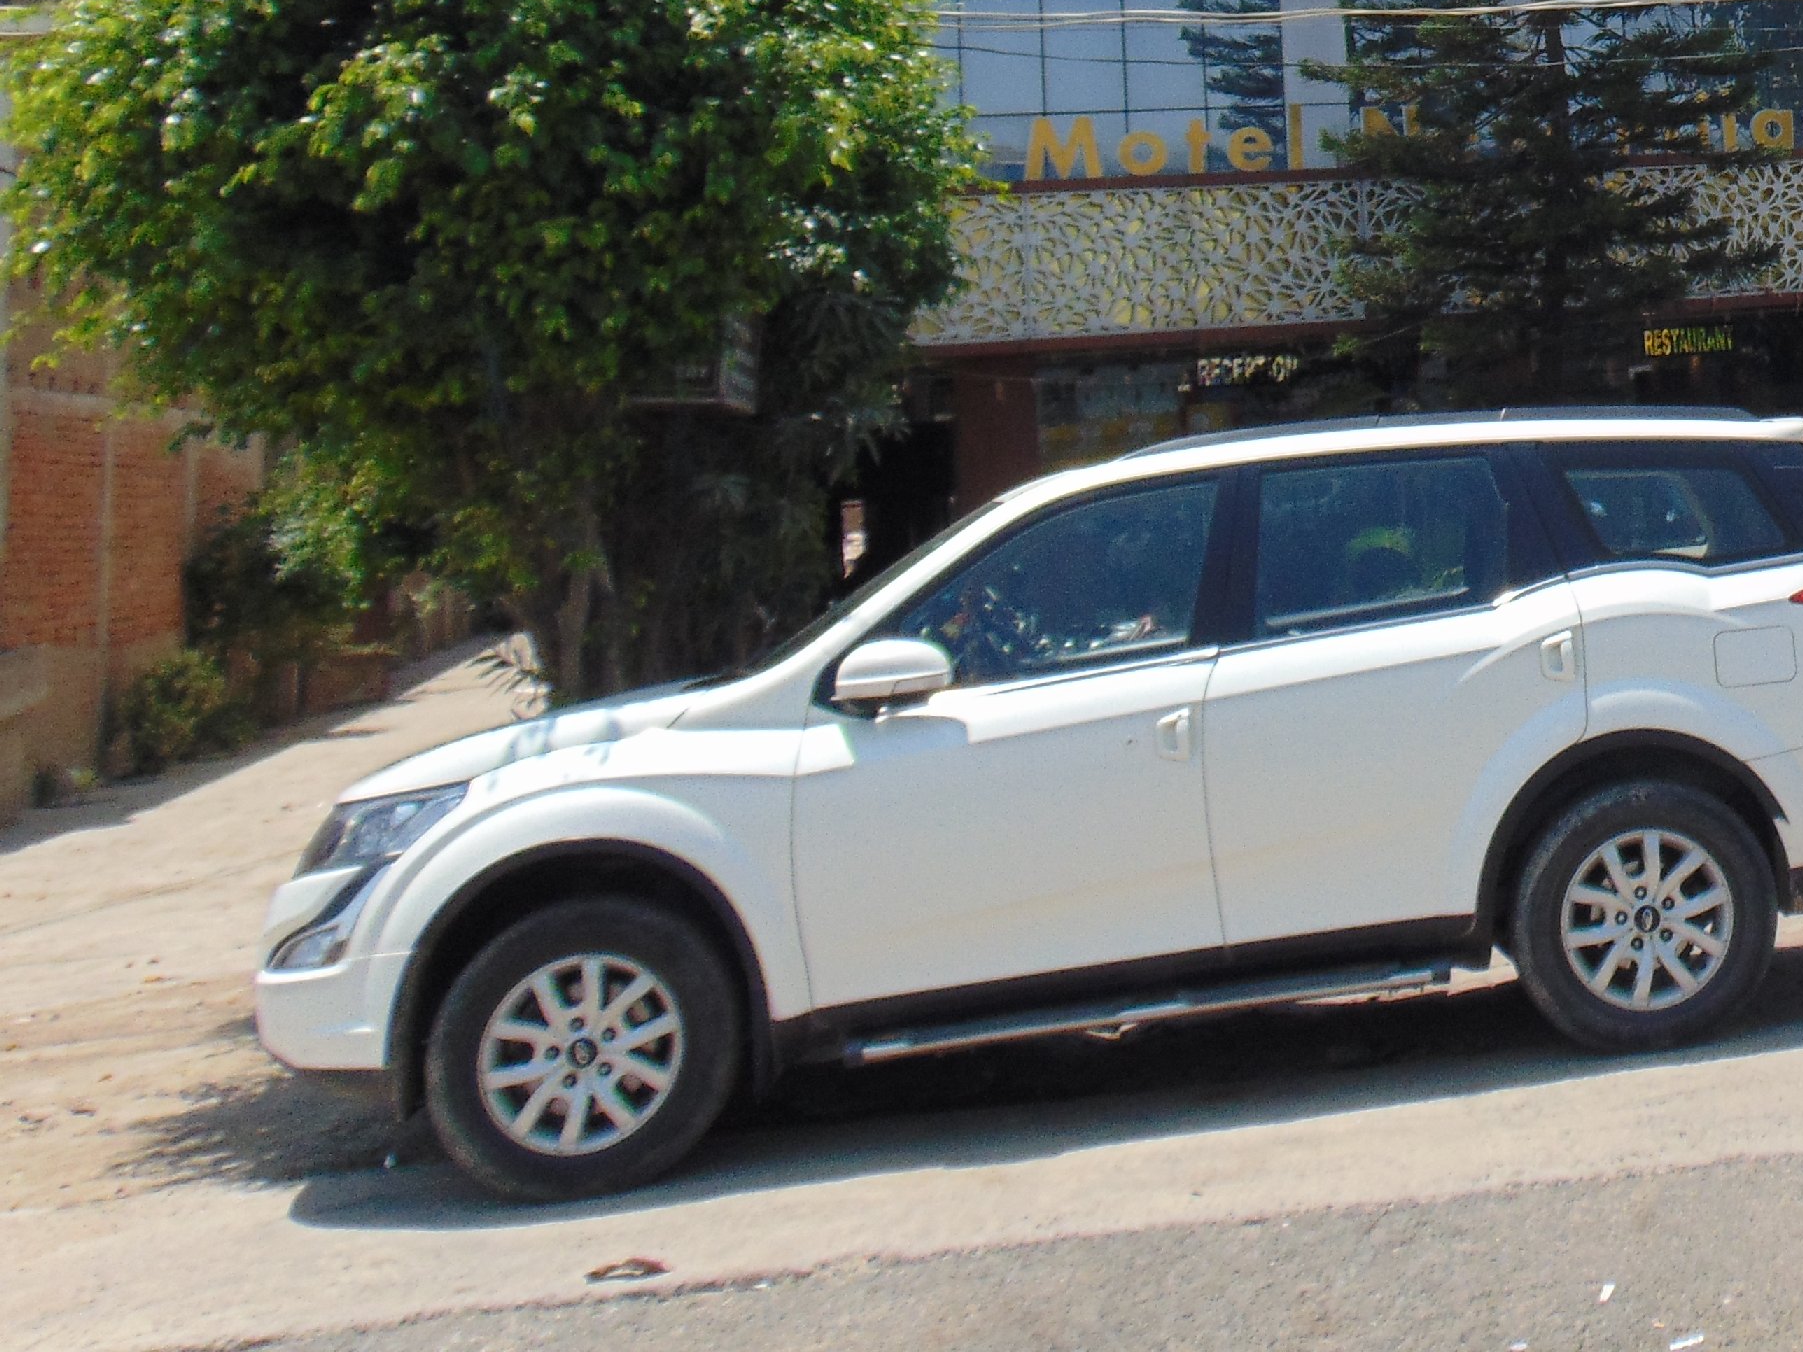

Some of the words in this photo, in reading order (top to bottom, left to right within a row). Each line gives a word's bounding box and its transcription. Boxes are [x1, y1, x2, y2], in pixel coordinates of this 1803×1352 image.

[1023, 103, 1302, 181] Motel
[1643, 325, 1733, 356] RESTAURANT
[1197, 355, 1298, 386] RECEPTON
